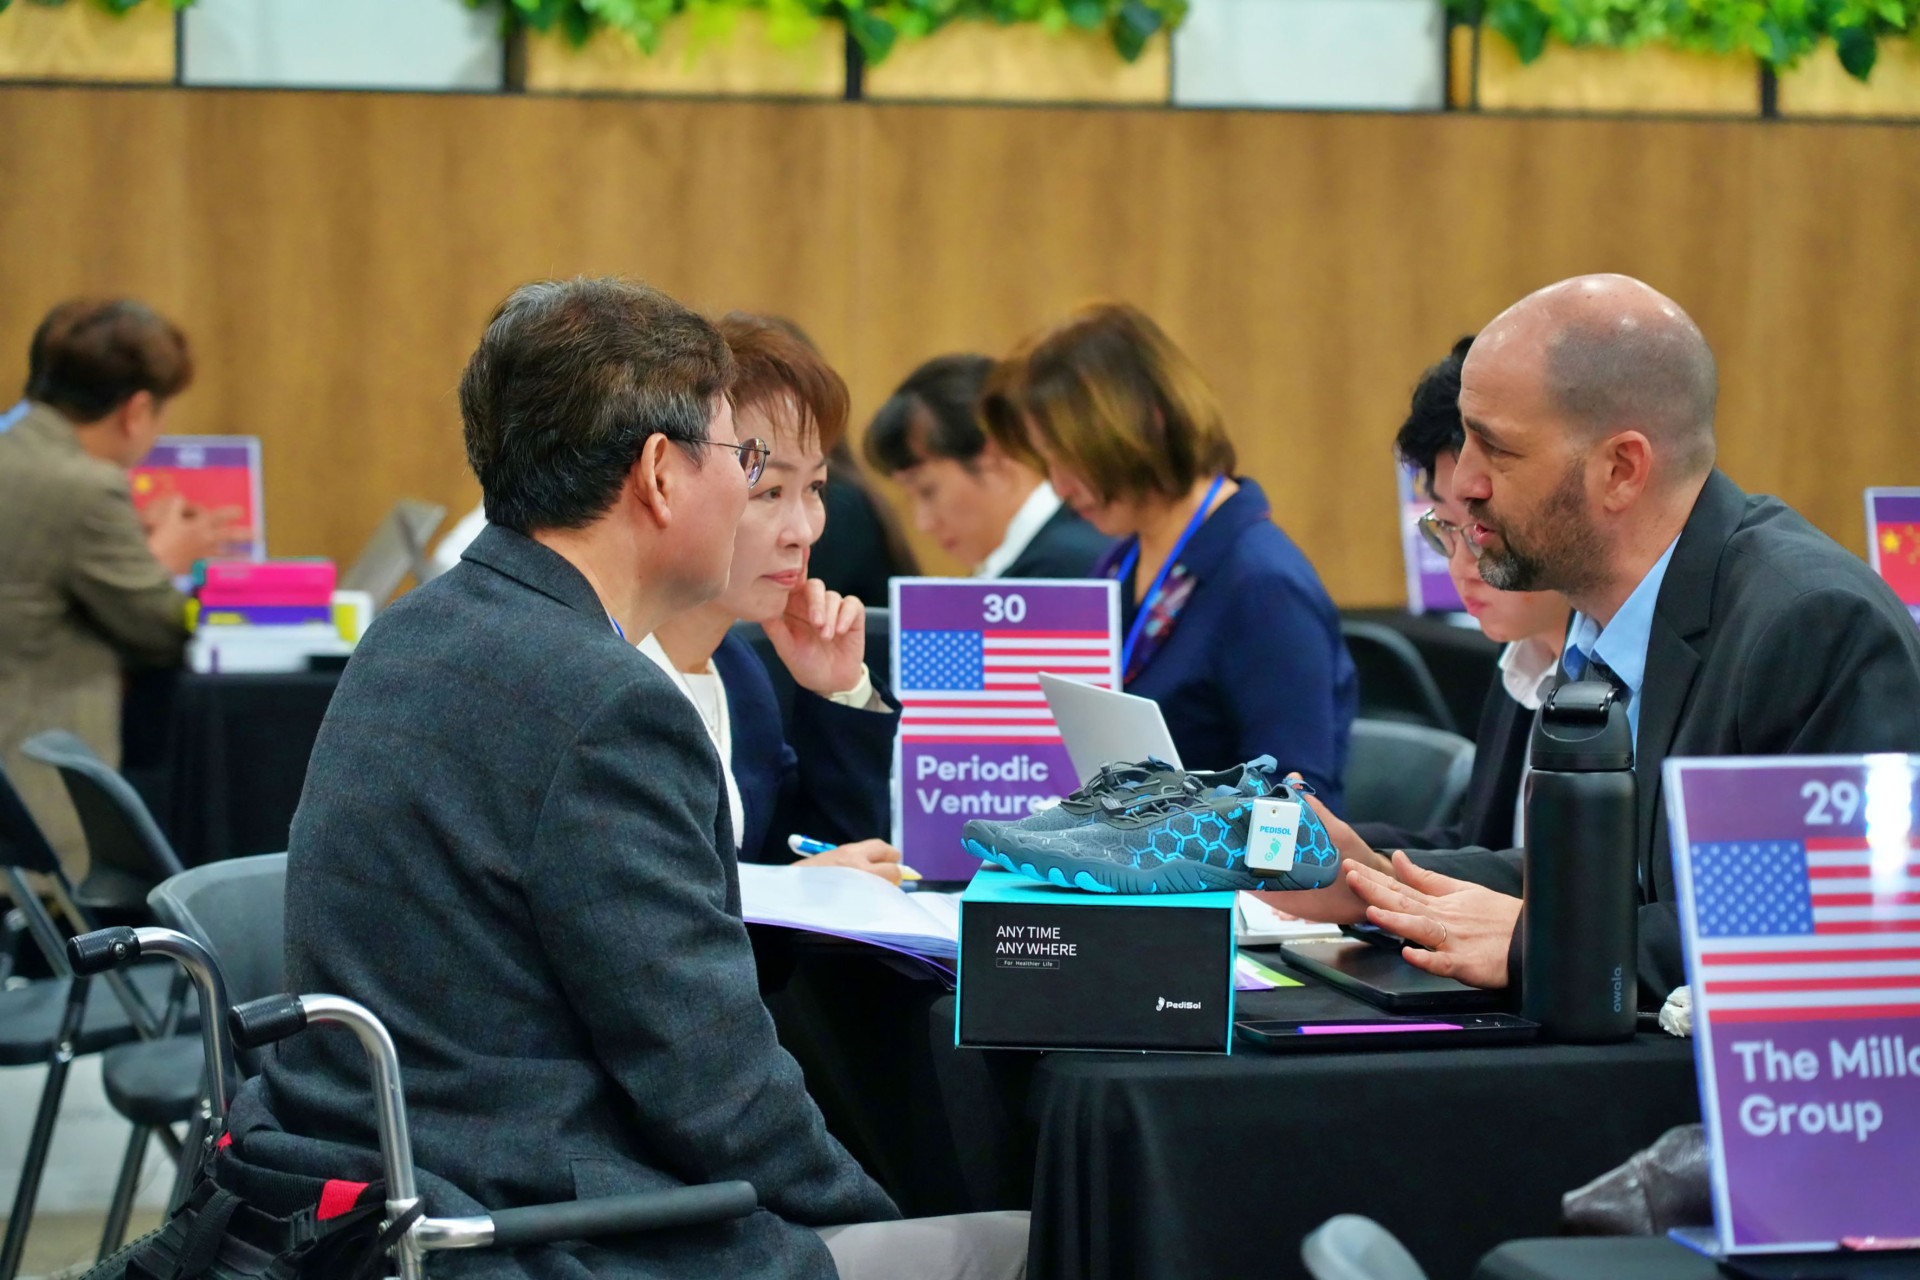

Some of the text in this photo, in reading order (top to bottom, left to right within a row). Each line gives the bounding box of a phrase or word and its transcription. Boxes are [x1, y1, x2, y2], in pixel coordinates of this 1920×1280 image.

[982, 593, 1027, 623] 30
[916, 754, 1049, 781] Periodic
[916, 788, 1063, 814] Venture
[1801, 779, 1860, 825] 29
[1260, 825, 1291, 835] PEDISOL
[996, 925, 1061, 939] ANY TIME
[996, 942, 1077, 956] ANY WHERE
[1166, 1001, 1201, 1009] PediSol
[1731, 1039, 1819, 1083] The
[1739, 1093, 1883, 1142] Group
